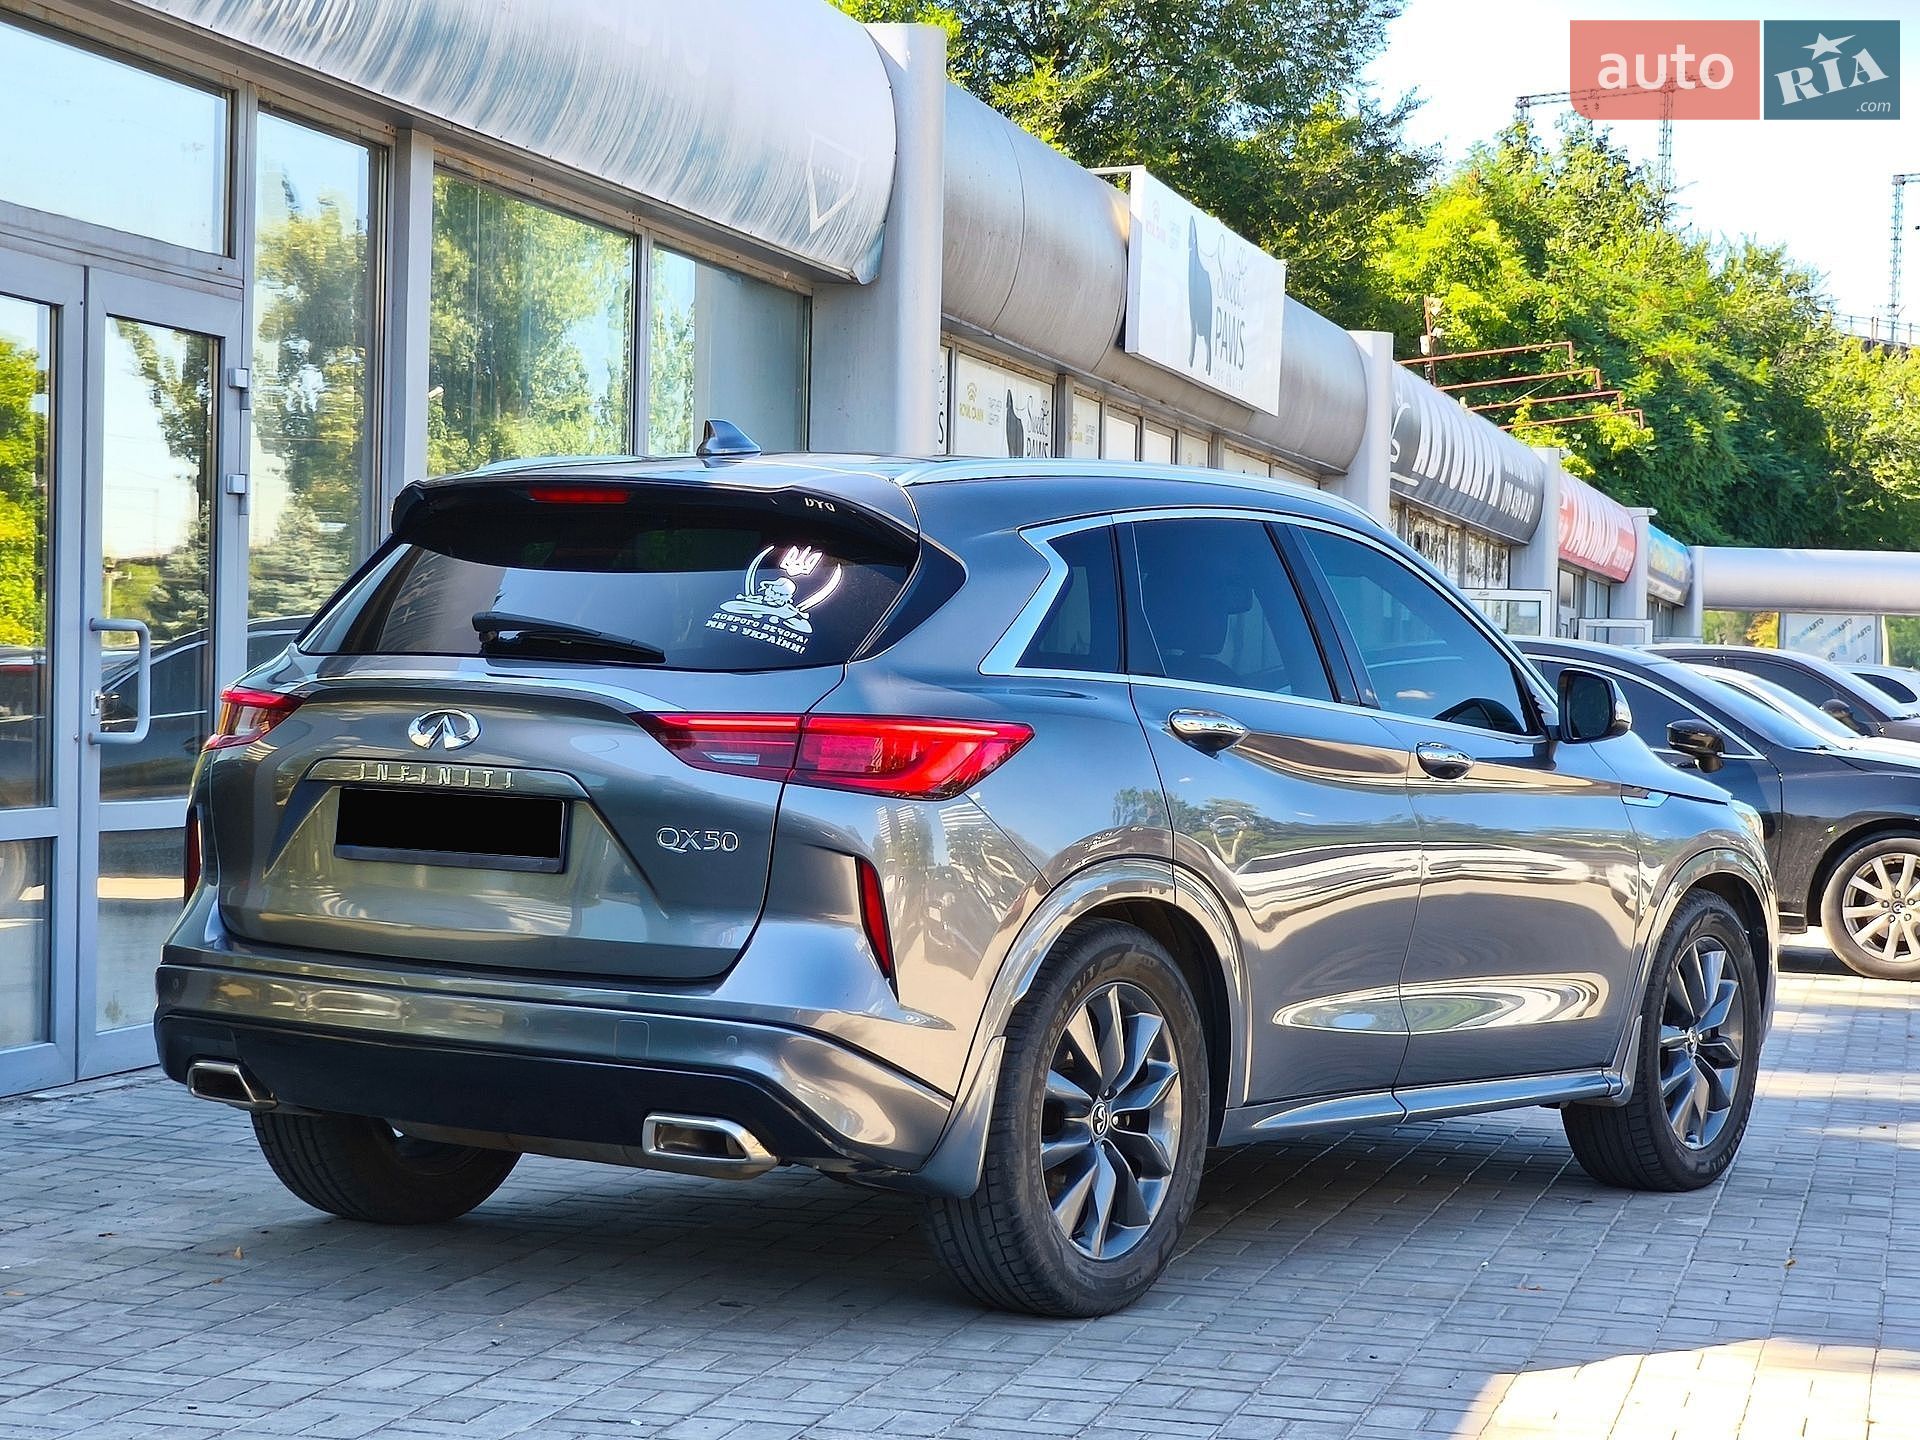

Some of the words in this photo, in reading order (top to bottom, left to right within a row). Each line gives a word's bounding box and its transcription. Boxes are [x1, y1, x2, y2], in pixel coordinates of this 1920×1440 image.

[1215, 306, 1245, 371] PAWS
[712, 612, 760, 629] ДОБРОГО
[762, 623, 809, 644] ВЕЧОРА!
[741, 628, 806, 654] УКРАЇНИ!
[359, 763, 515, 789] INFINITI
[656, 826, 740, 853] QX50
